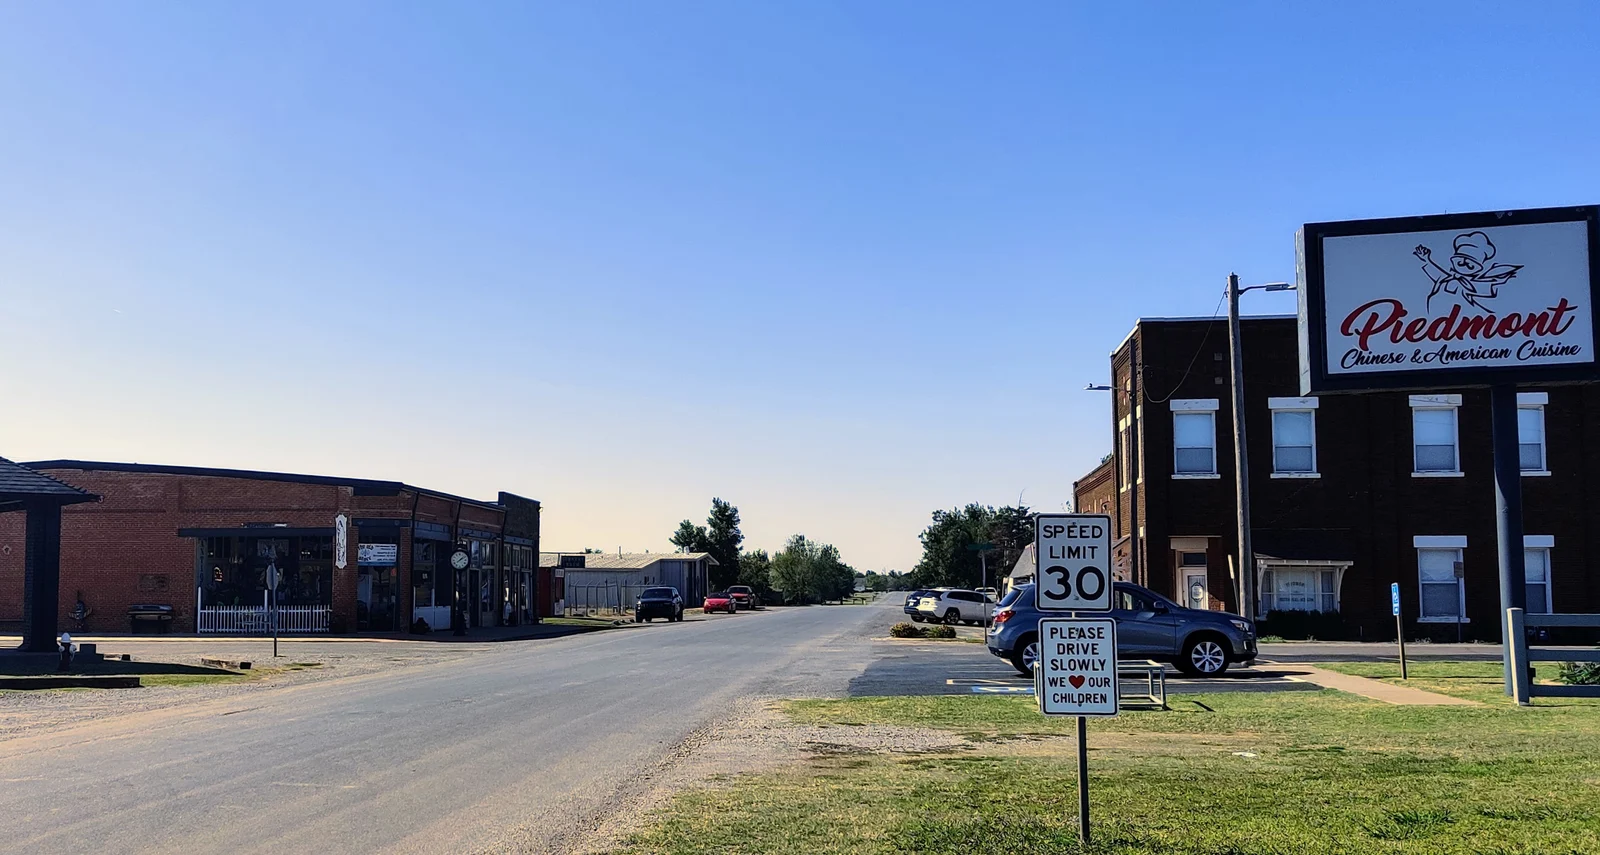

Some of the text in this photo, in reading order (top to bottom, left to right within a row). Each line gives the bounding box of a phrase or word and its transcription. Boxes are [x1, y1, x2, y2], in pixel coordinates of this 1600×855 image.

[1340, 298, 1578, 351] Piedmont
[1341, 349, 1405, 369] Chinese
[1516, 340, 1581, 362] Cuisine
[1042, 525, 1103, 539] SPEED
[1049, 546, 1098, 559] LIMIT
[1043, 565, 1105, 601] 30
[1050, 627, 1105, 639] PLEASE
[1057, 643, 1099, 655] DRIVE
[1050, 658, 1106, 671] SLOWLY
[1048, 675, 1111, 688] WE OUR
[1052, 693, 1107, 704] CHILDREN
